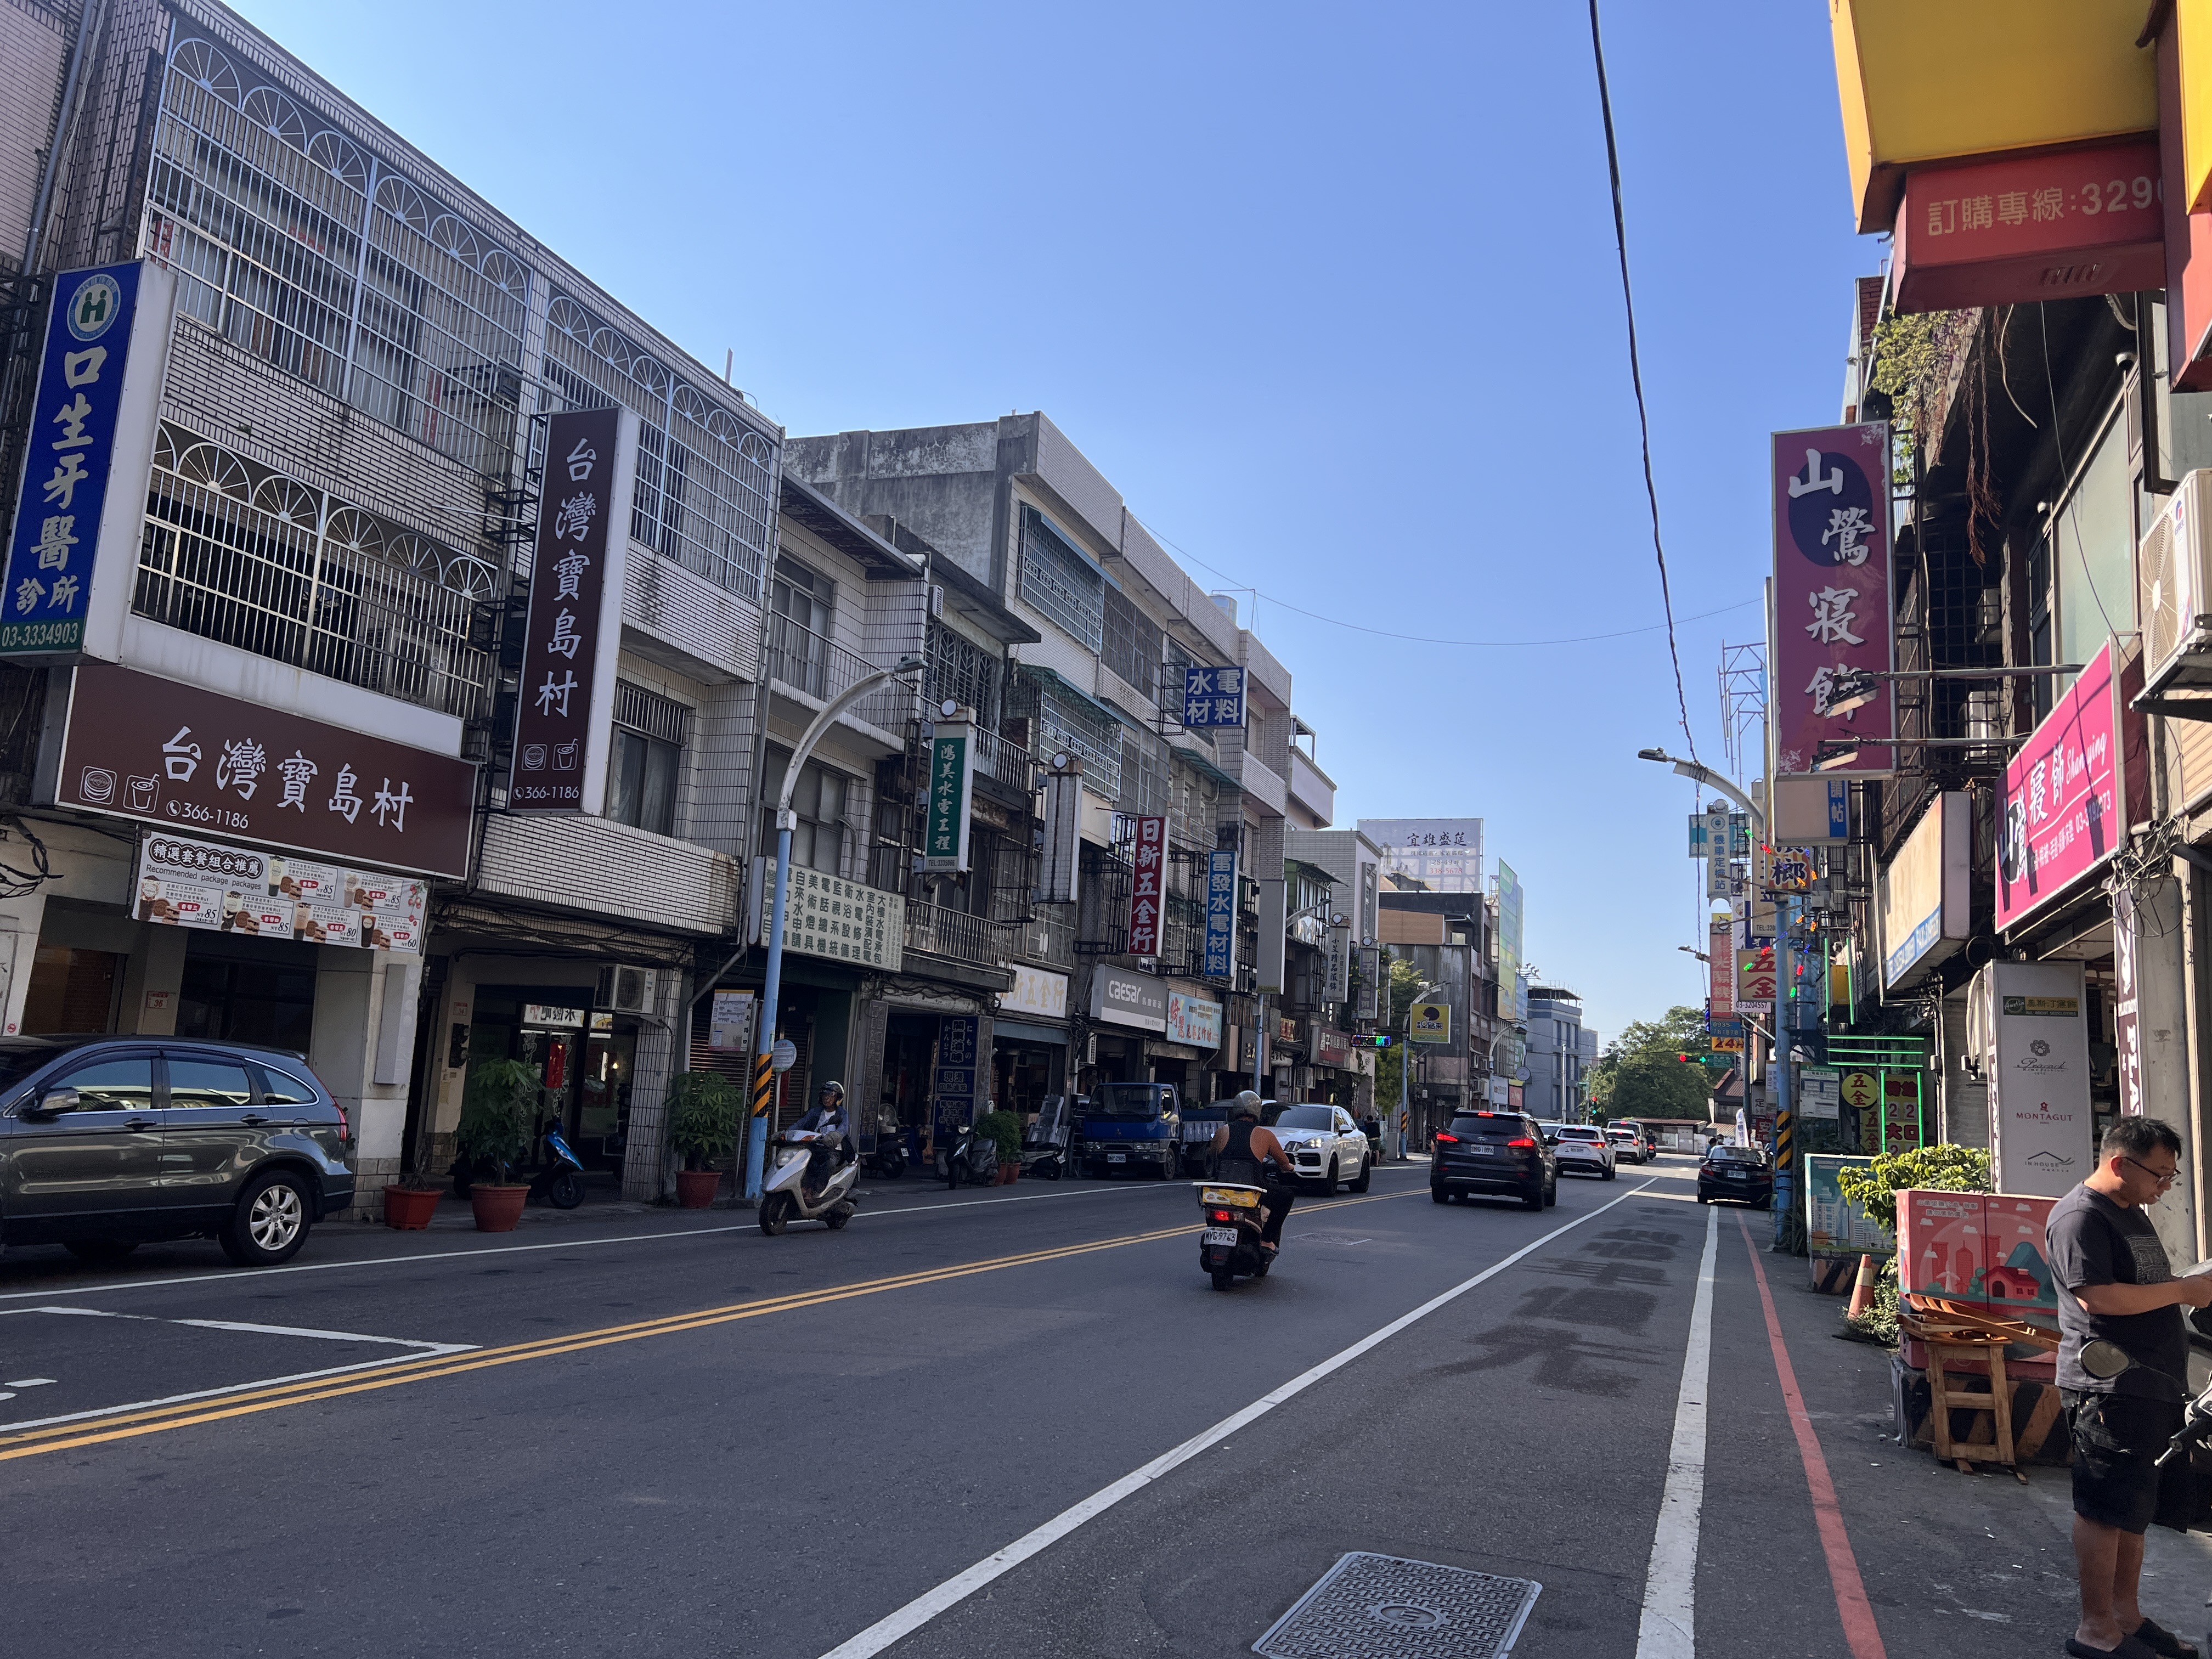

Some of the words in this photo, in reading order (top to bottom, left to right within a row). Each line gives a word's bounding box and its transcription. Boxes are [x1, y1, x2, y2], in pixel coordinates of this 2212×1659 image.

[1927, 176, 2164, 235] 訂購專線:329
[30, 346, 108, 571] 口生牙醫
[16, 575, 79, 615] 診所
[534, 438, 597, 717] 台灣寶島村
[2, 623, 78, 647] 03-3334903
[162, 726, 414, 833] 台灣寶島村
[525, 786, 579, 800] 366-1186
[935, 744, 955, 850] 鴻美水電工程
[182, 800, 249, 829] 366-1186
[146, 864, 197, 879] Recommended
[201, 874, 228, 885] package
[232, 879, 261, 890] packages
[153, 843, 260, 876] 精選套餐組合推薦
[1131, 819, 1160, 953] 日新五金行
[792, 871, 805, 948] 自來水申請
[804, 873, 818, 951] 美術燈具
[817, 877, 830, 953] 電話總機
[829, 881, 842, 956] 監視系統
[841, 884, 853, 958] 衛浴設備
[852, 888, 865, 960] 水電修理
[863, 891, 876, 962] 室內裝潢配電
[874, 895, 886, 964] 大樓水電承包
[1207, 853, 1232, 973] 雷發水電材料
[154, 999, 163, 1007] 36
[1109, 980, 1142, 1004] caesar
[1713, 955, 1731, 1013] 光陽機車
[1850, 1075, 1871, 1105] 五金
[2017, 1057, 2066, 1069] Peacock
[2016, 1113, 2073, 1121] MONTAGUT
